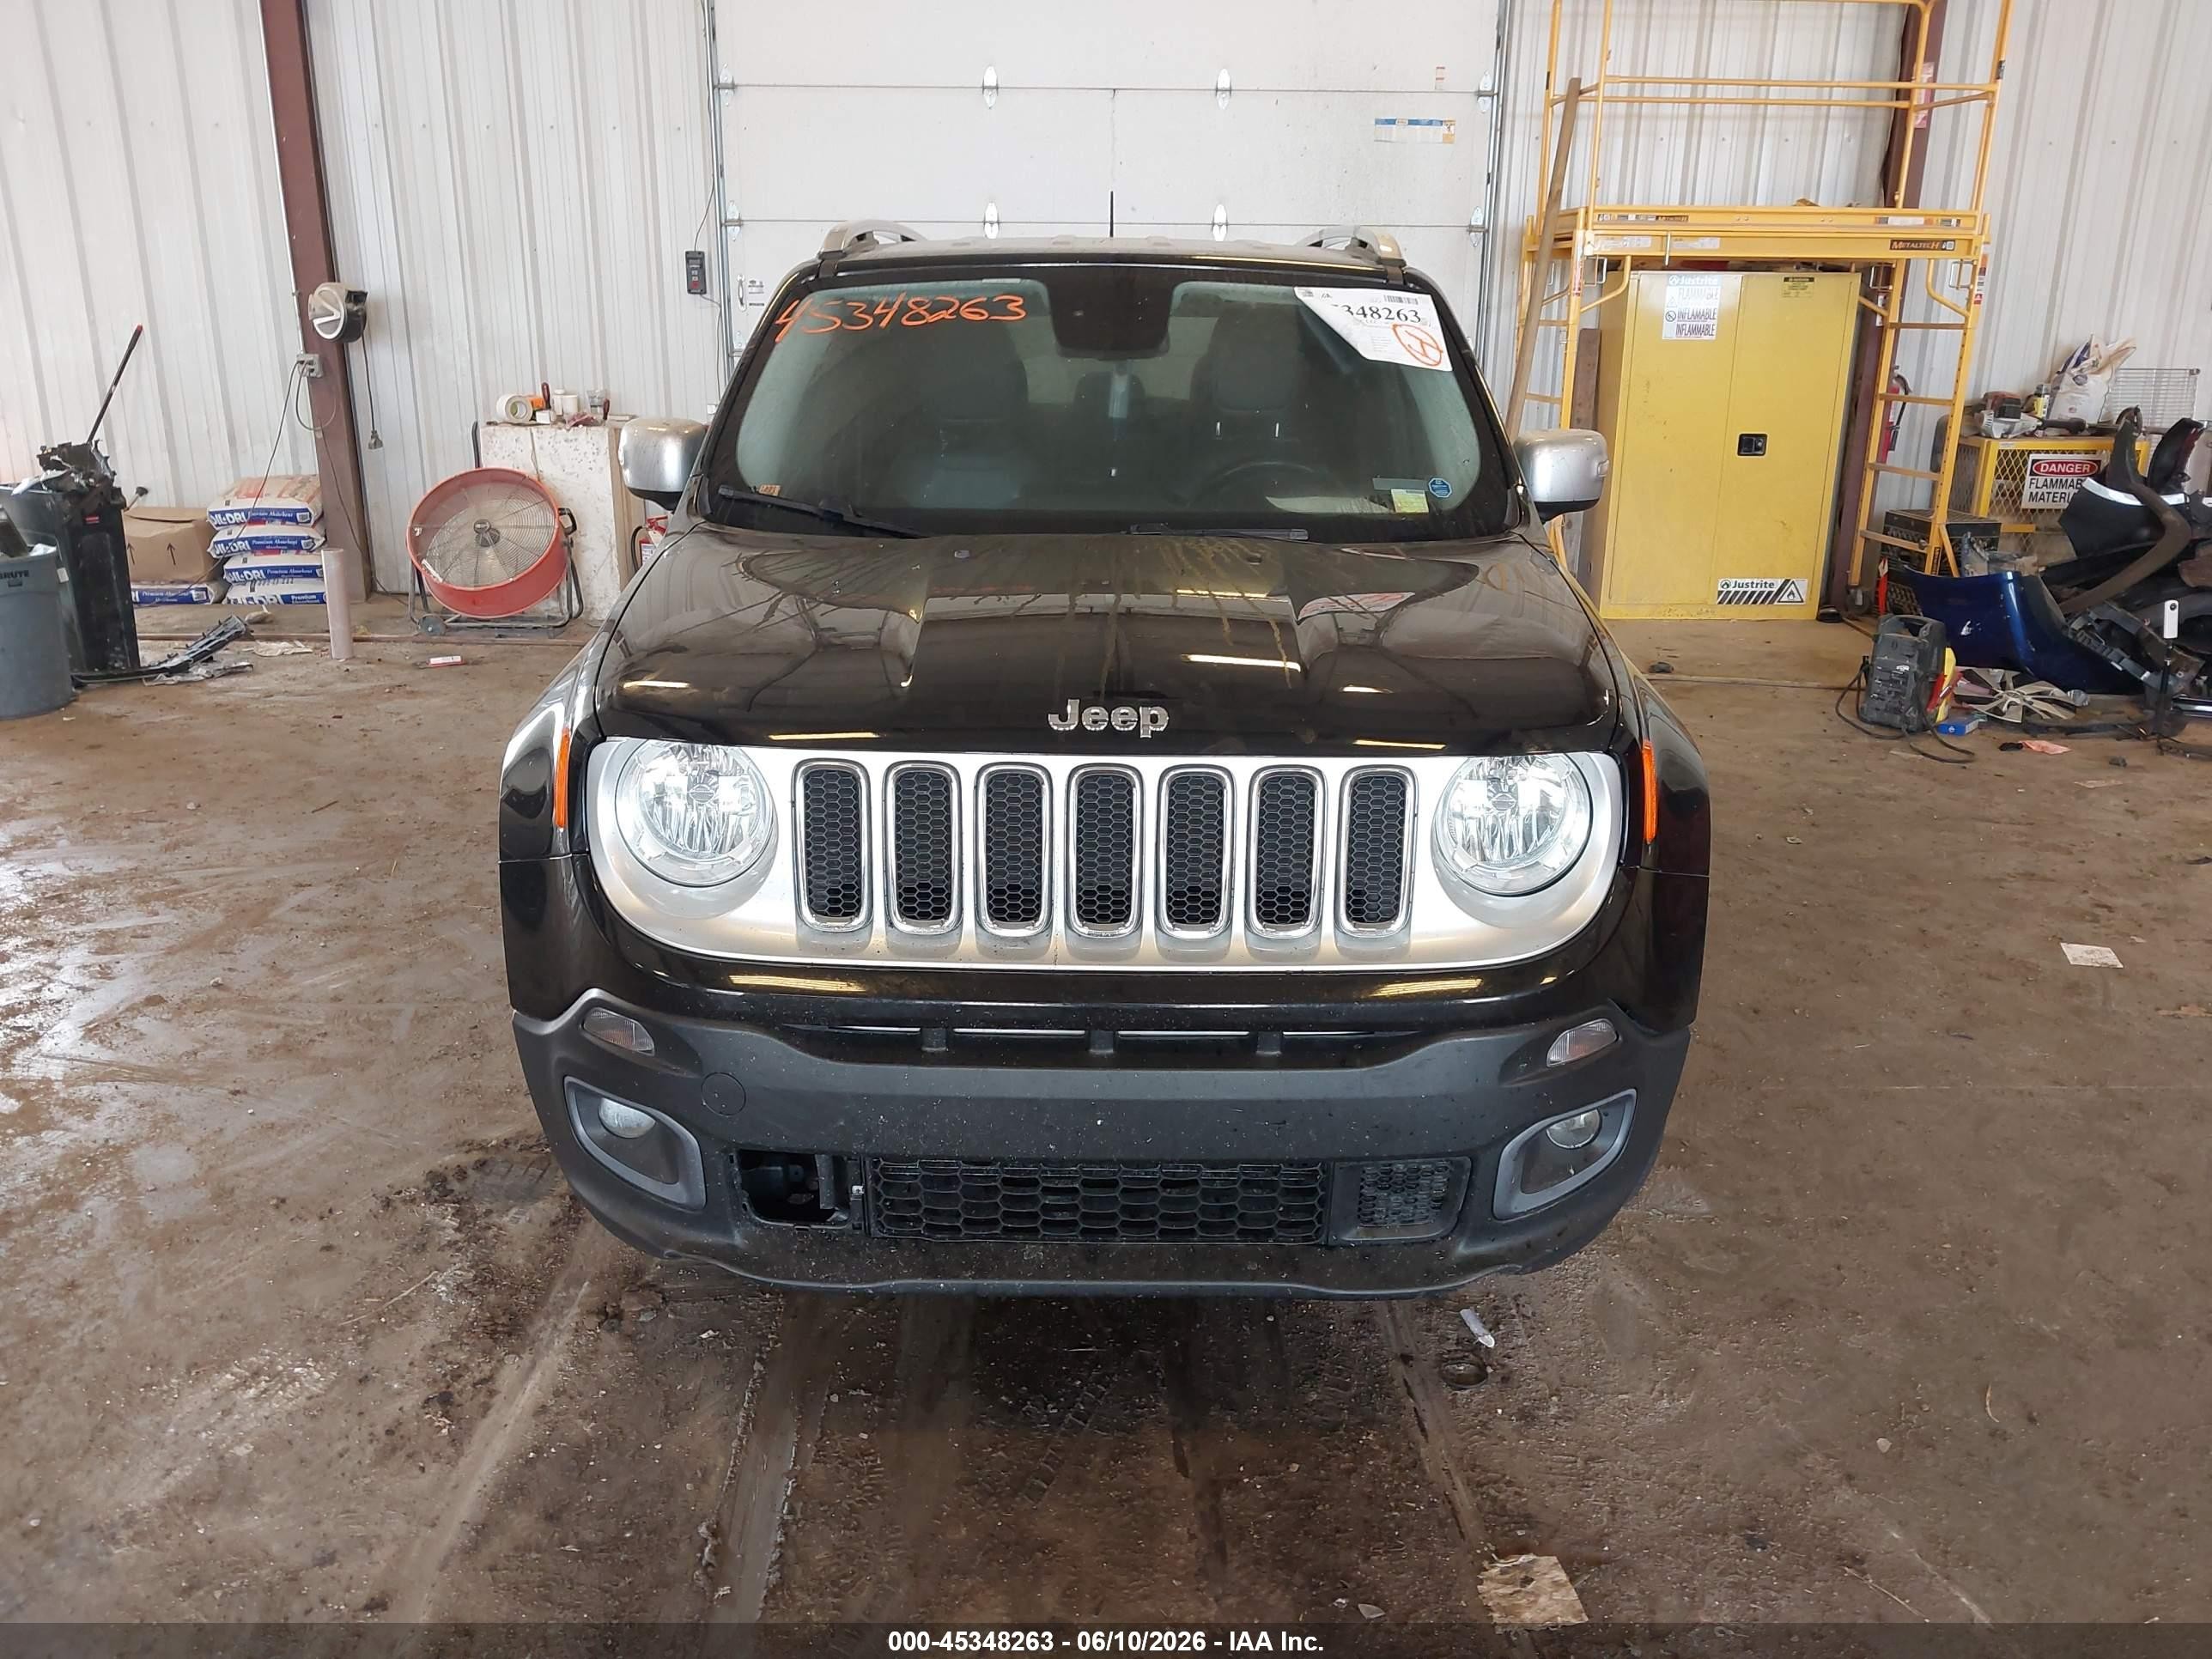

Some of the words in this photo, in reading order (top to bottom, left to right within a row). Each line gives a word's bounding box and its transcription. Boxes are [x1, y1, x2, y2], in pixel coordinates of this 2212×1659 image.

[775, 291, 1026, 343] 45348263
[1331, 303, 1421, 323] 348263
[1677, 307, 1717, 320] INFLAMABLE
[1675, 323, 1716, 337] INFLAMMABLE
[2039, 463, 2091, 473] DANGER
[1732, 580, 1775, 589] Justrite
[1048, 699, 1170, 738] Jeep
